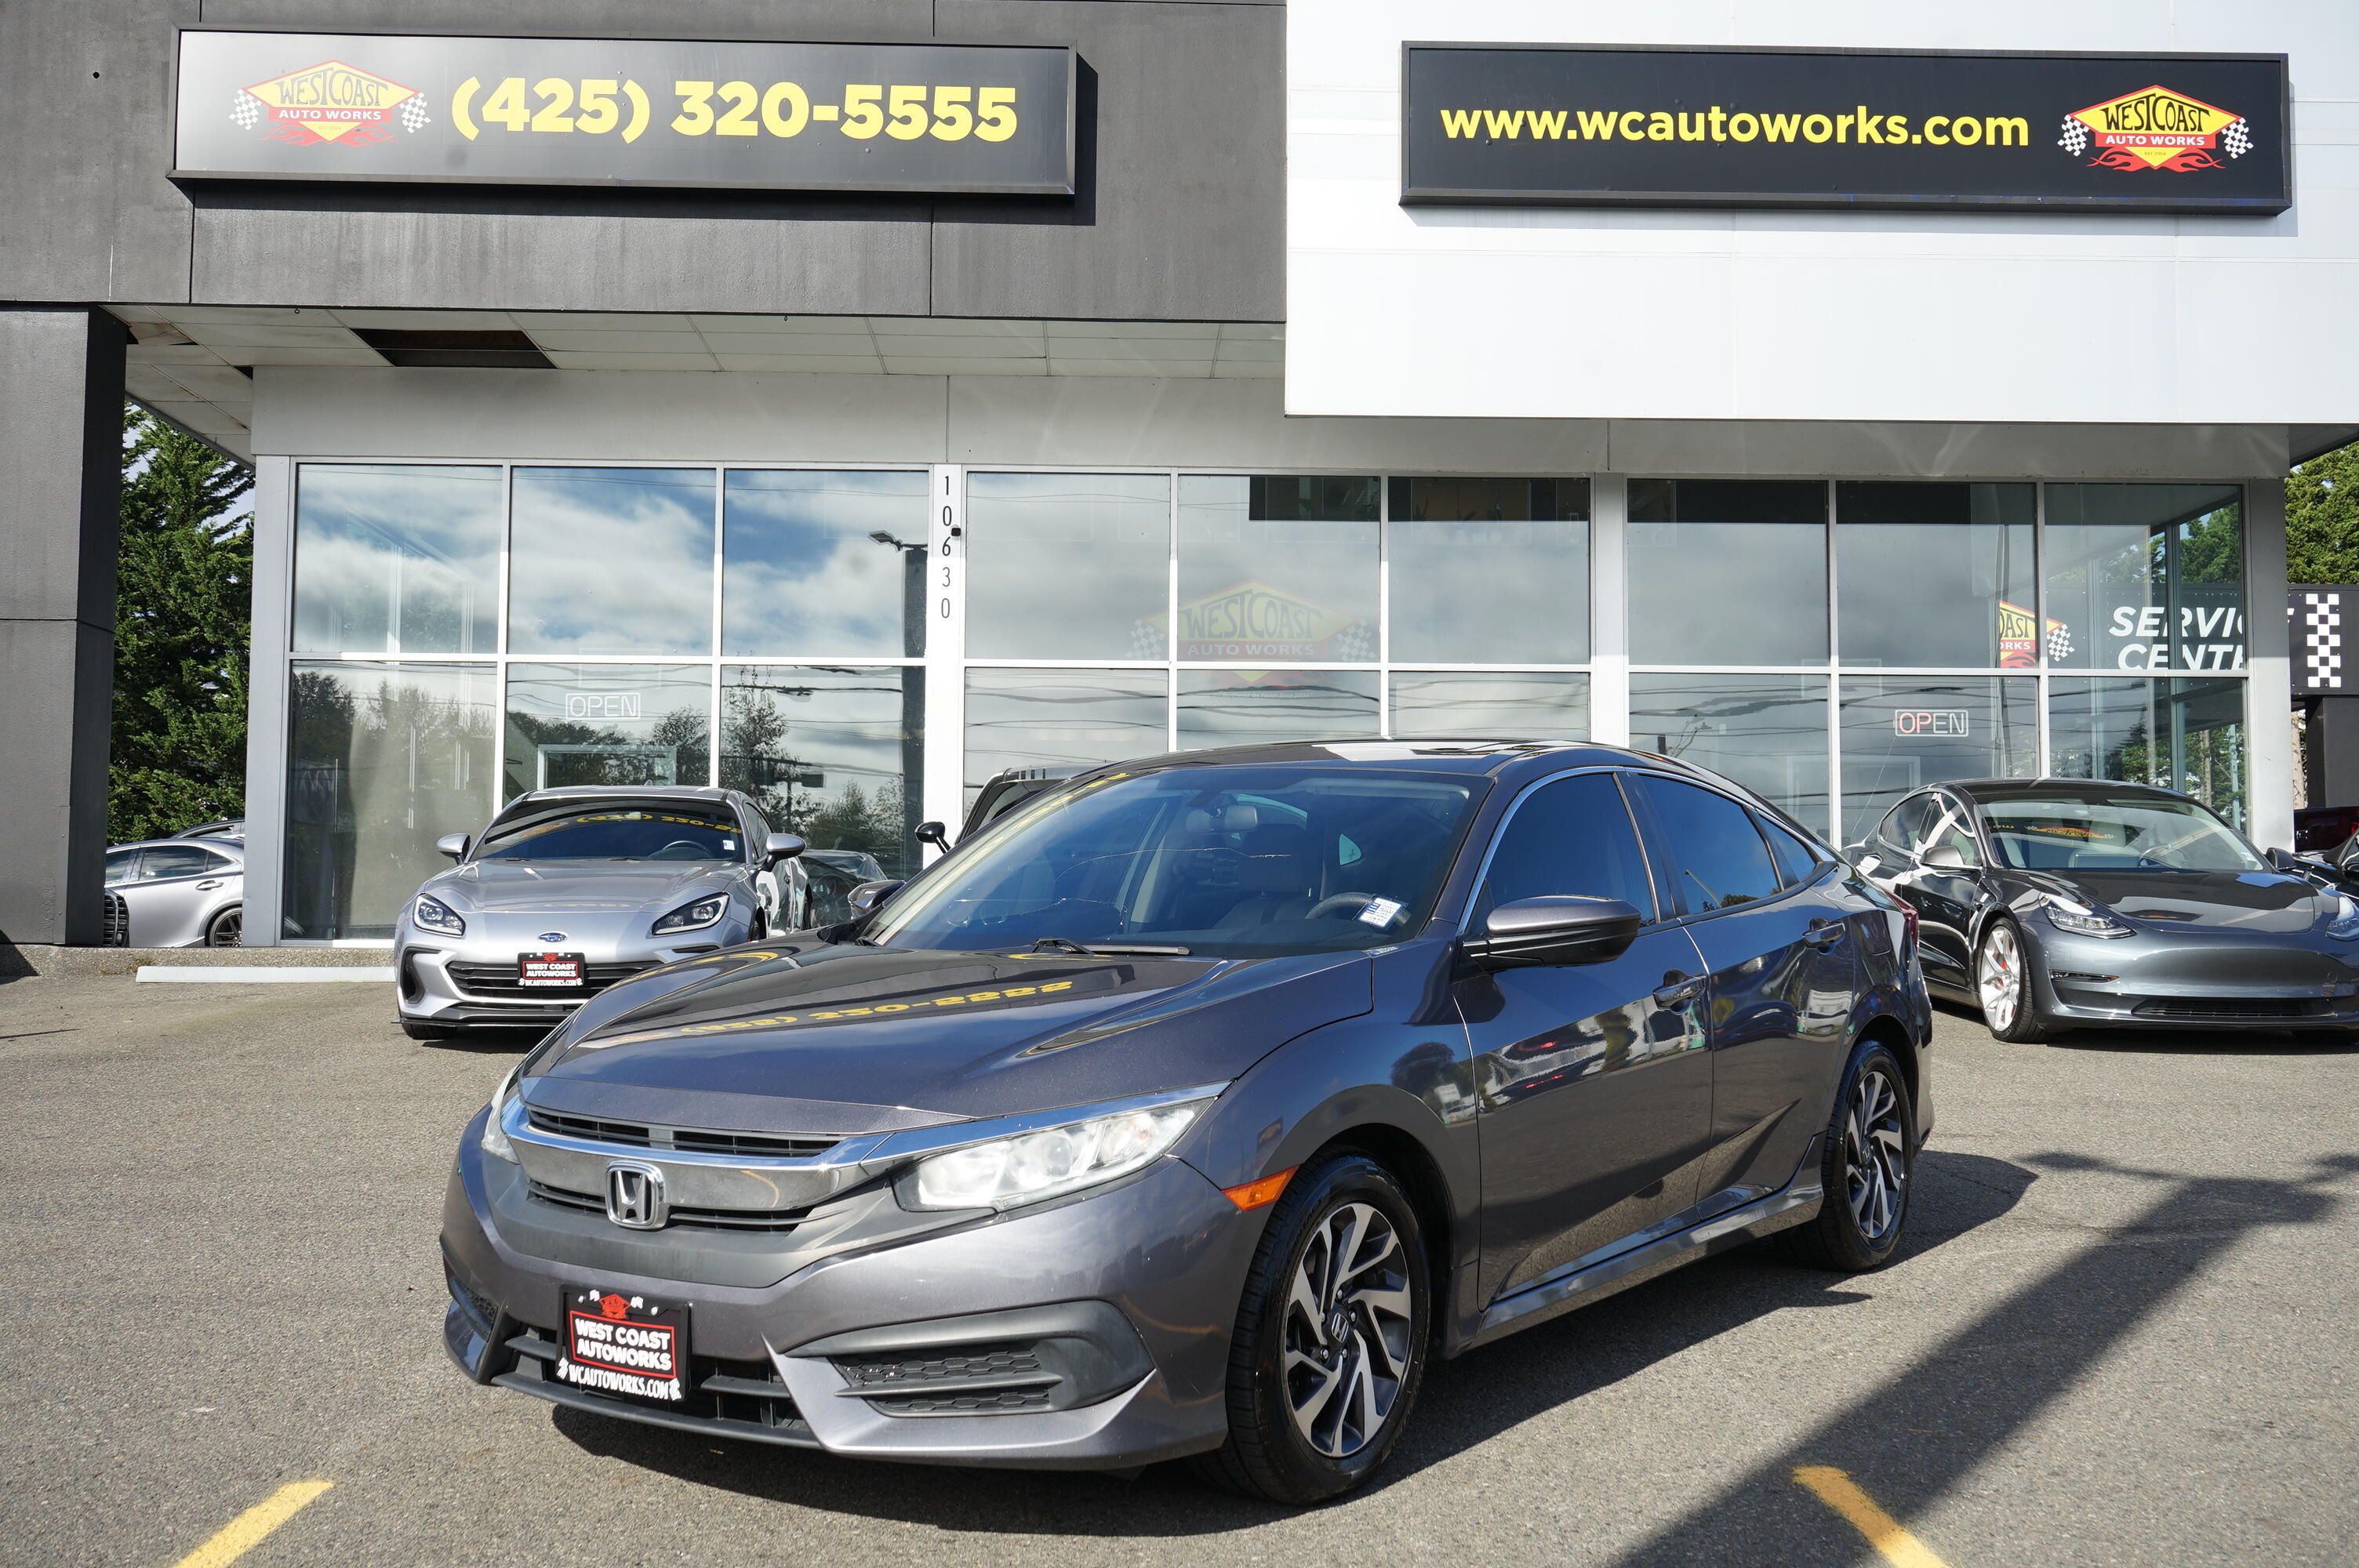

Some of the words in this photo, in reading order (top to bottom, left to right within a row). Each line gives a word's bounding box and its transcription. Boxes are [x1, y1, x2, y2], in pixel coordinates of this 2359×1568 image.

[278, 109, 322, 119] AUTO
[323, 110, 381, 120] WORKS
[452, 76, 650, 144] (425)
[671, 81, 1017, 142] 320-5555
[1441, 106, 2030, 147] www.wcautoworks.com
[2106, 135, 2146, 145] AUTO
[2150, 136, 2205, 146] WORKS
[1187, 644, 1241, 655] AUTO
[1245, 644, 1314, 655] WORKS
[570, 695, 637, 717] OPEN
[1899, 712, 1964, 734] OPEN
[575, 1319, 613, 1343] WEST
[615, 1325, 671, 1350] COAST
[576, 1338, 672, 1371] AUTOWORKS
[568, 1364, 670, 1400] WCAUTOWORKS.COM
